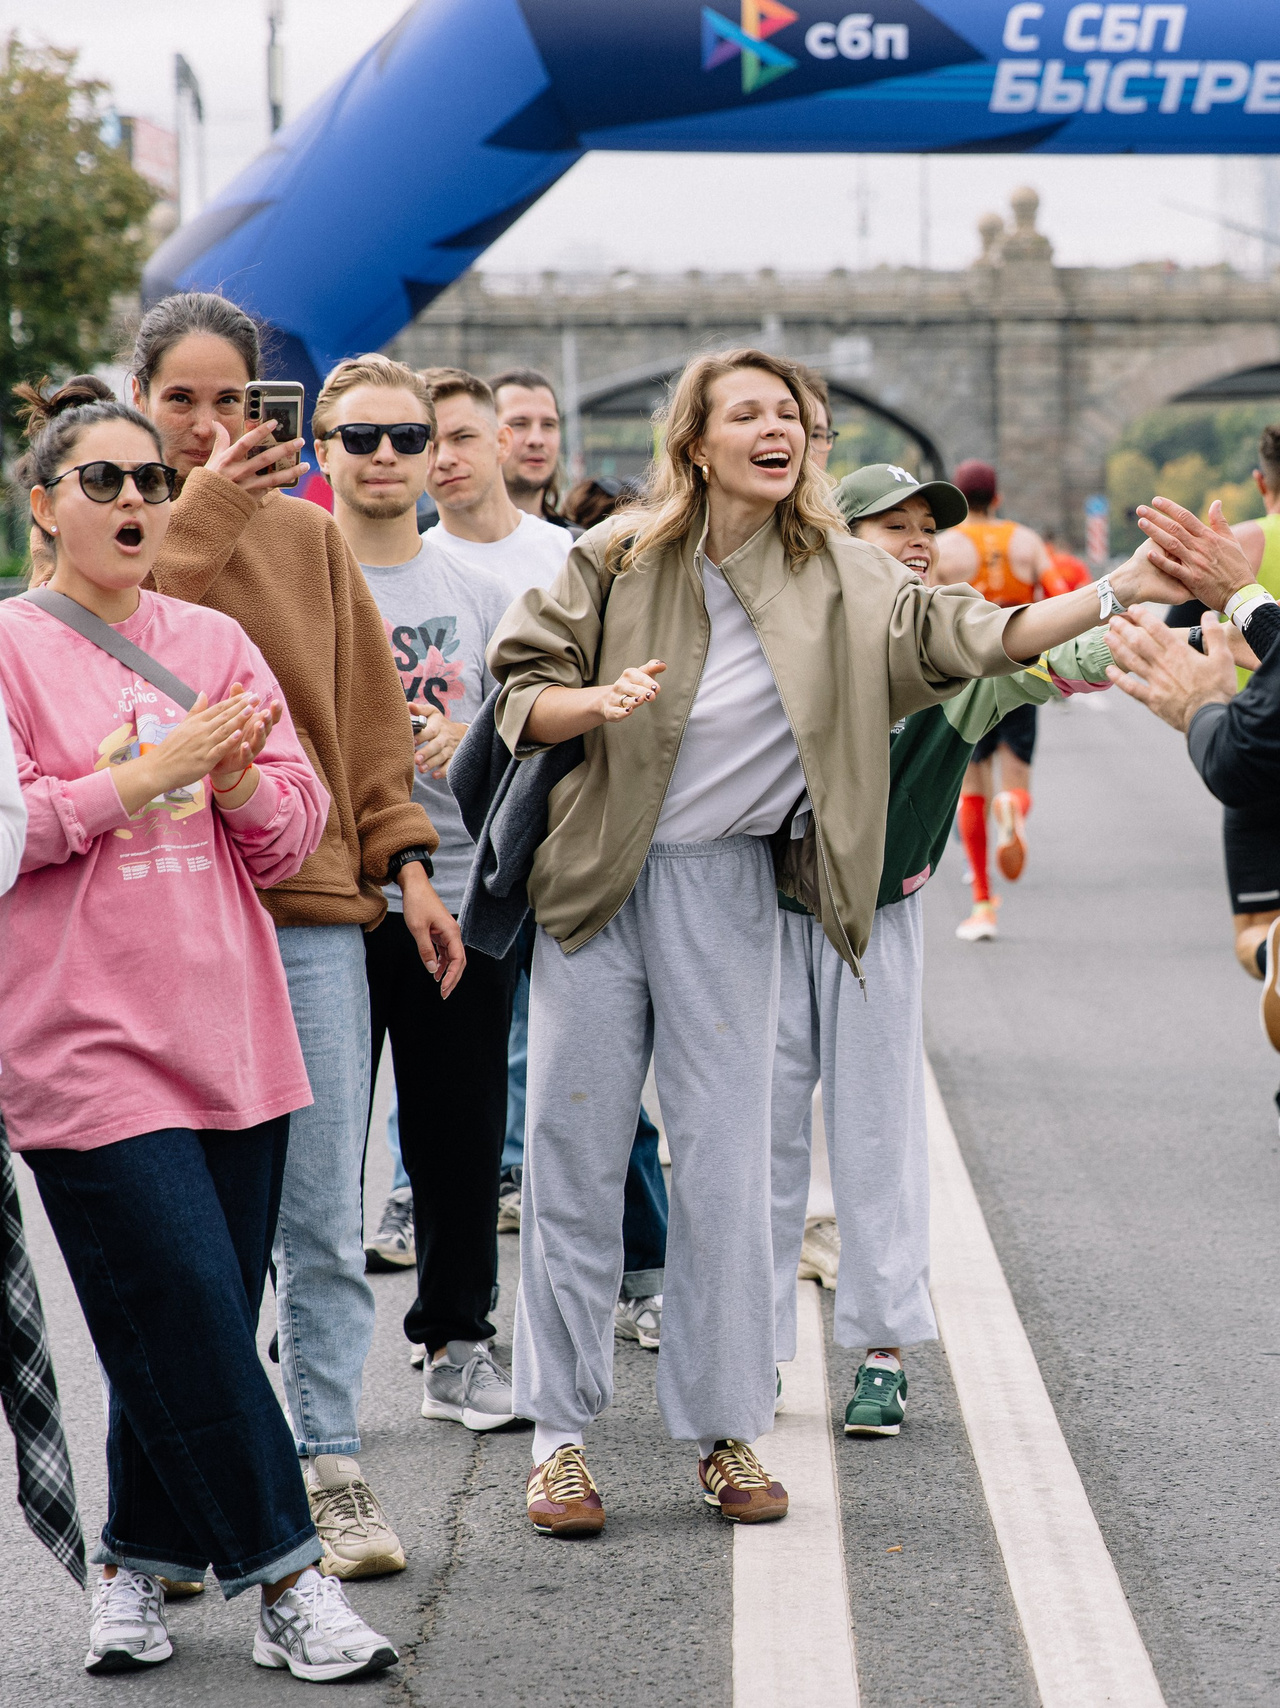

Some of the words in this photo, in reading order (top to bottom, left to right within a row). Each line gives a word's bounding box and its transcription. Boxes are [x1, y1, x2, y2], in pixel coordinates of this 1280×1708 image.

[805, 14, 909, 60] сбп
[1002, 2, 1045, 52] С
[1062, 2, 1188, 52] СБП
